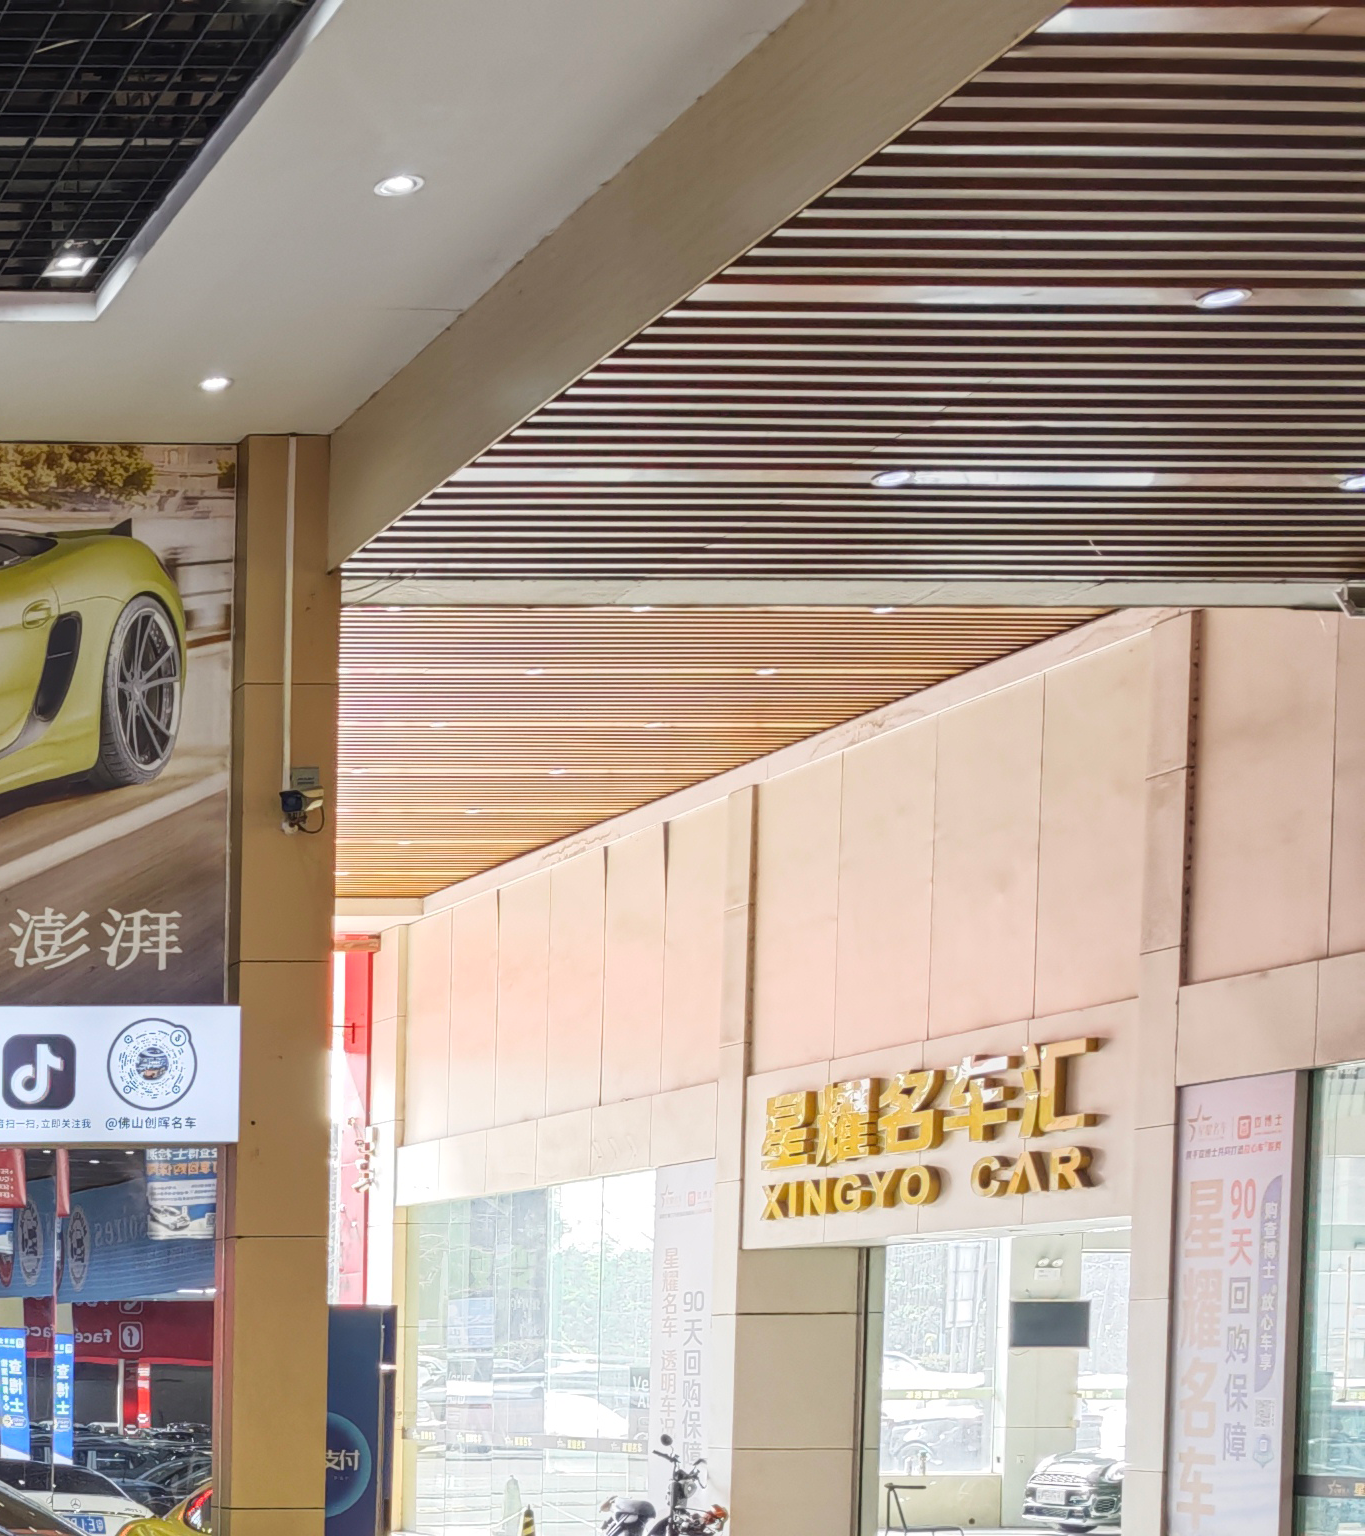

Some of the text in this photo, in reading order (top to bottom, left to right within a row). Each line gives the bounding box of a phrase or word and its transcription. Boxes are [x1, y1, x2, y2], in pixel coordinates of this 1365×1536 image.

[105, 1116, 197, 1130] @佛山创晖名车
[761, 1037, 1101, 1171] 星耀名车汇
[761, 1146, 1095, 1221] XINGYO CAR
[661, 1247, 680, 1339] 星耀名车
[1222, 1178, 1257, 1462] 90天回购保障
[1176, 1178, 1225, 1531] 星耀名车
